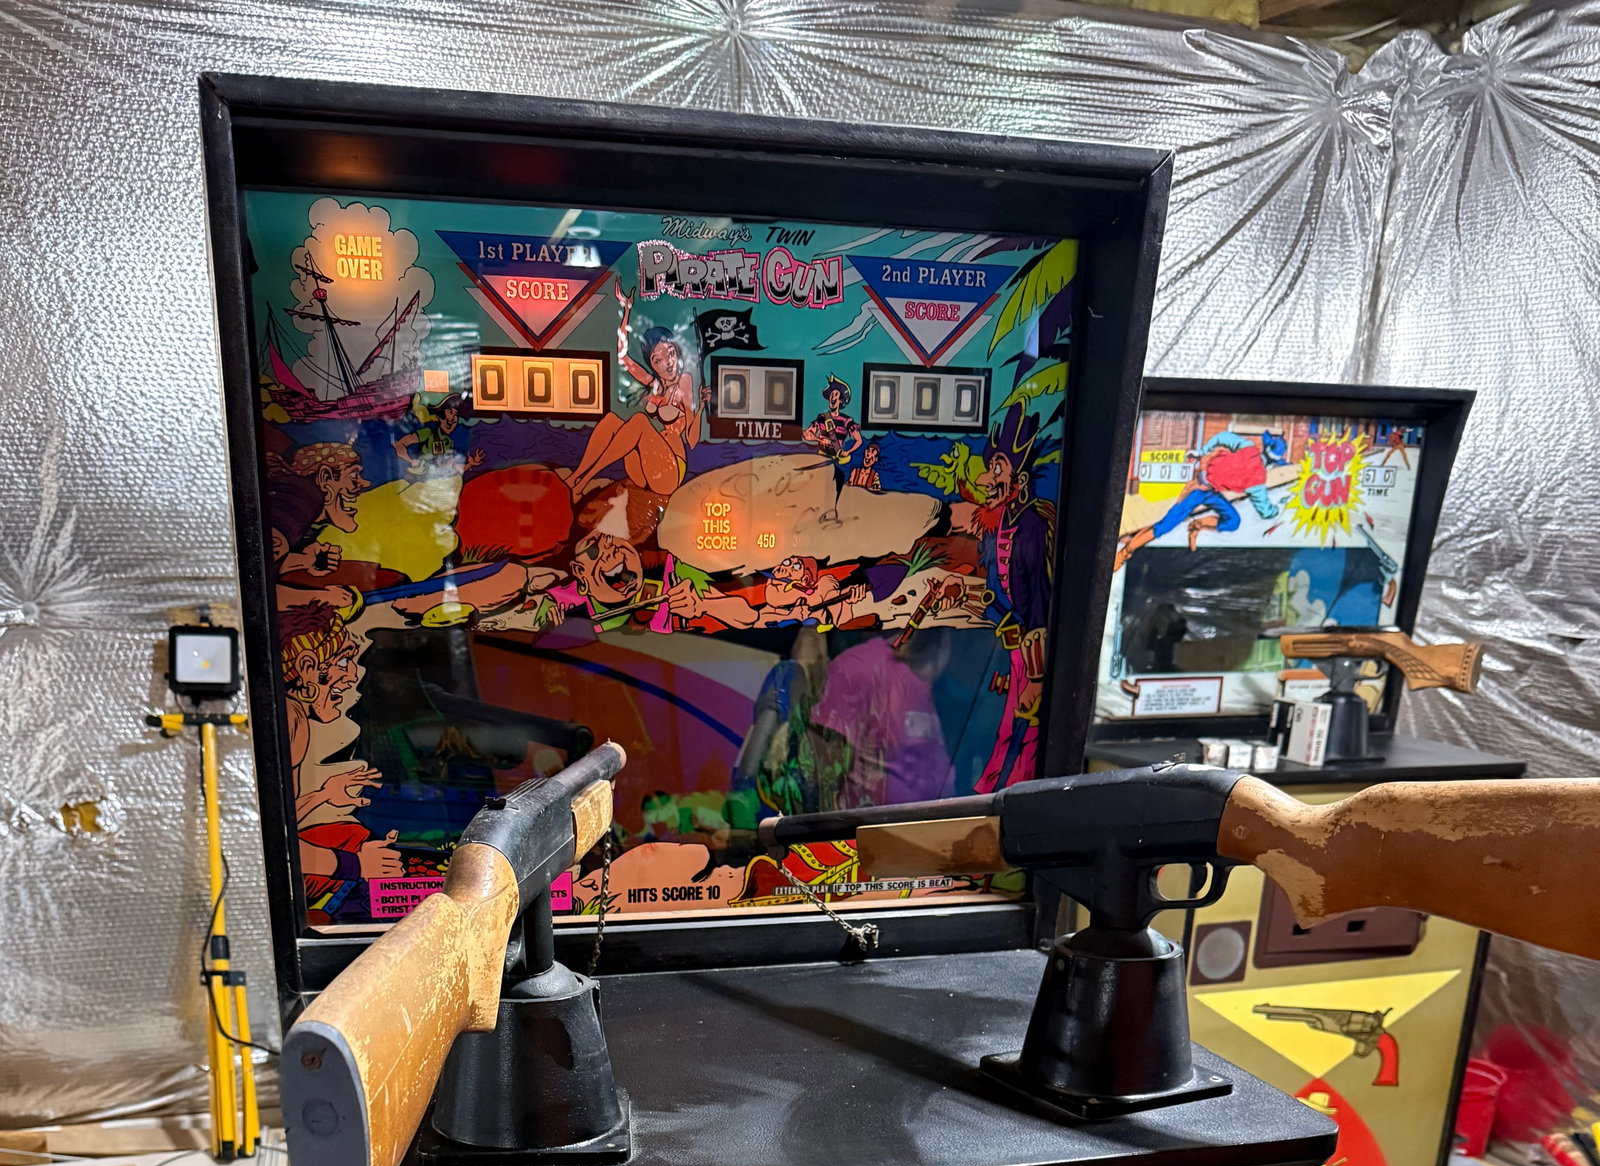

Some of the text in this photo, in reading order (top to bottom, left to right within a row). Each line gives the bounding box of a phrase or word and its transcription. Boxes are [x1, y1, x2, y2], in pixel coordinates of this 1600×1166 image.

[661, 216, 816, 247] Midway's TWIN
[334, 233, 382, 257] GAME
[479, 241, 503, 260] 1st
[336, 257, 383, 280] OVER
[639, 242, 844, 309] PIRATE GUN
[882, 264, 987, 288] 2nd PLAYER
[506, 279, 569, 301] SCORE
[905, 301, 961, 321] SCORE
[735, 421, 782, 438] TIME
[1150, 452, 1180, 462] SCORE
[1310, 442, 1355, 474] TOP
[1303, 474, 1352, 508] GUN
[1368, 488, 1389, 497] TIME
[704, 502, 731, 517] TOP
[702, 519, 731, 534] THIS
[696, 536, 737, 551] SCORE
[757, 533, 775, 549] 450
[380, 881, 444, 891] INSTRUCTION
[627, 884, 721, 903] HITS SCORE 10
[811, 885, 830, 894] PLAY
[834, 884, 842, 893] IF
[844, 883, 861, 891] TOP
[865, 882, 884, 891] THIS
[887, 880, 915, 889] SCORE
[917, 880, 926, 888] IS
[929, 878, 951, 887] BEAT
[381, 895, 409, 904] BOTH
[381, 905, 409, 914] FIRST
